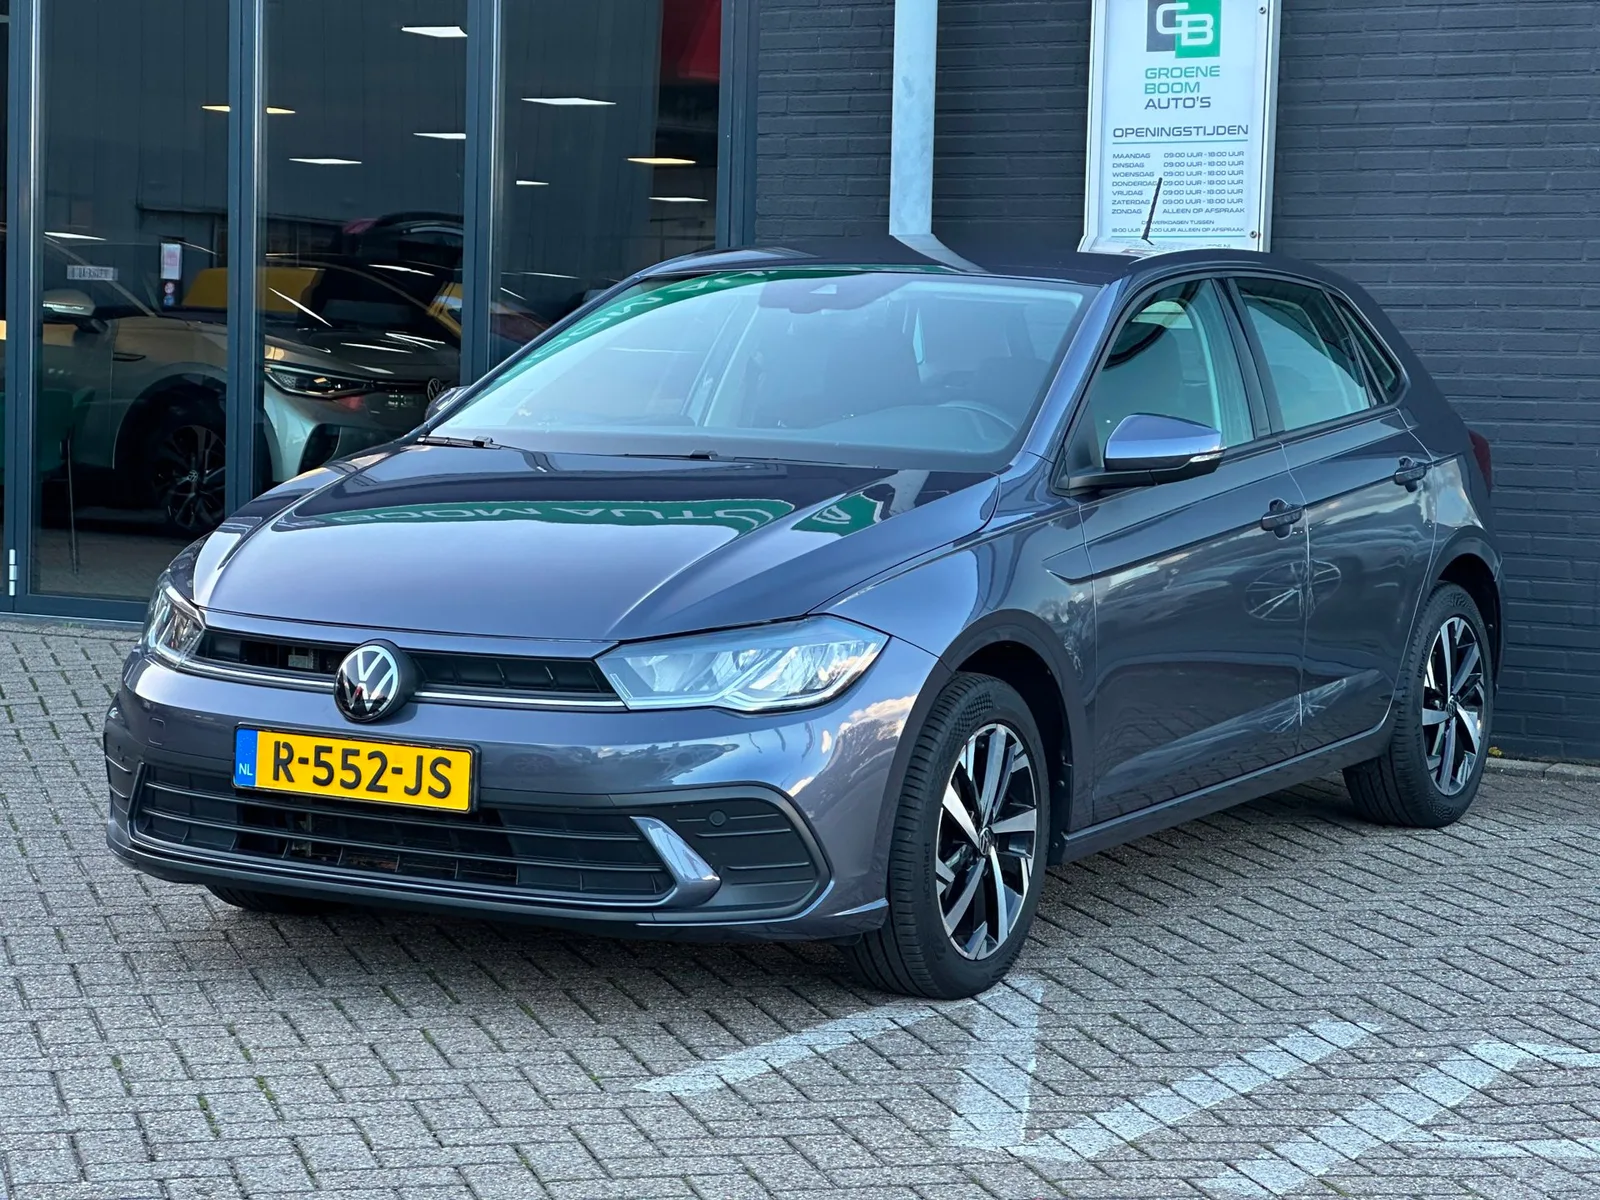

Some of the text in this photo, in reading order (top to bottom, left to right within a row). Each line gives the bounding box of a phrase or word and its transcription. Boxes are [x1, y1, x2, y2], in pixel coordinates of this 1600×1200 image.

[1145, 65, 1220, 79] GROENE
[1144, 81, 1200, 95] BOOM
[1144, 96, 1211, 110] AUTO'S
[1112, 124, 1249, 138] OPENINGSTIJDEN
[238, 762, 253, 776] NL
[272, 740, 452, 799] R-552-JS
